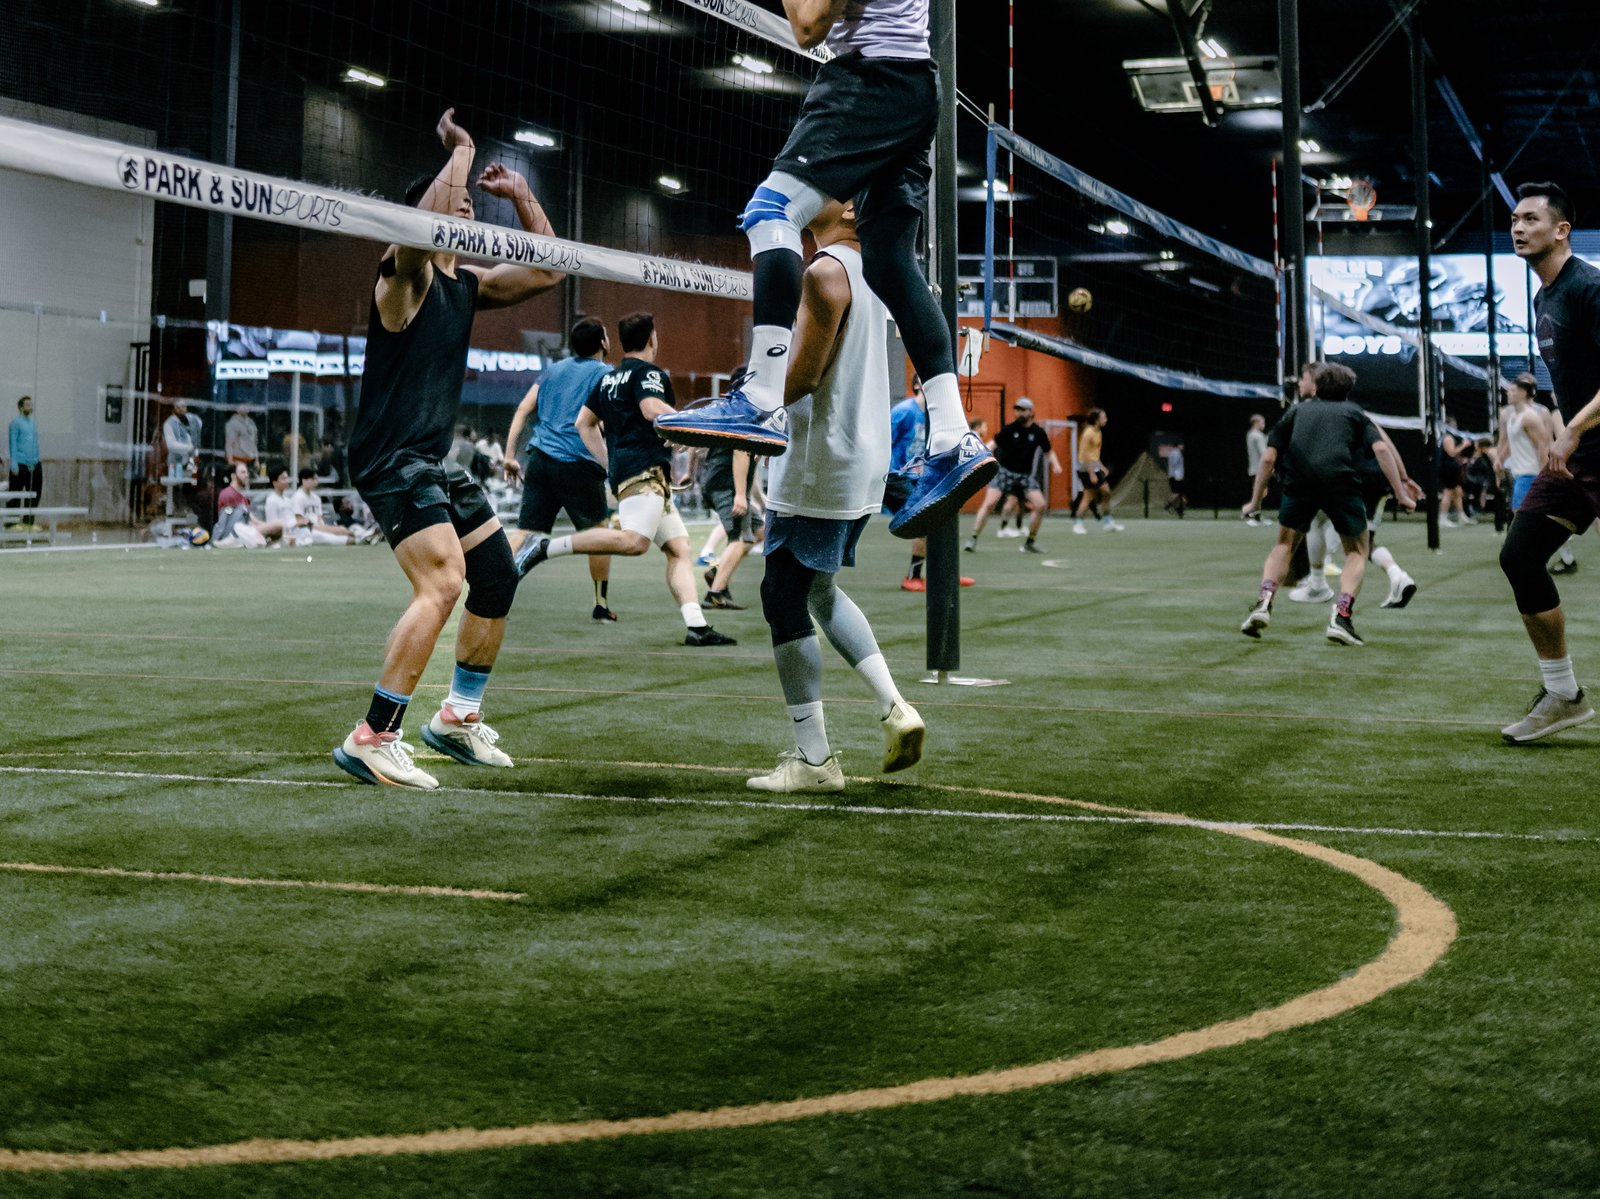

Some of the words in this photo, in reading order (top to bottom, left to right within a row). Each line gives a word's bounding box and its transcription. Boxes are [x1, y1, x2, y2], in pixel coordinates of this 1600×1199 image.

[145, 158, 202, 201] PARK
[210, 172, 224, 205] &
[448, 221, 487, 255] PARK
[491, 230, 500, 257] &
